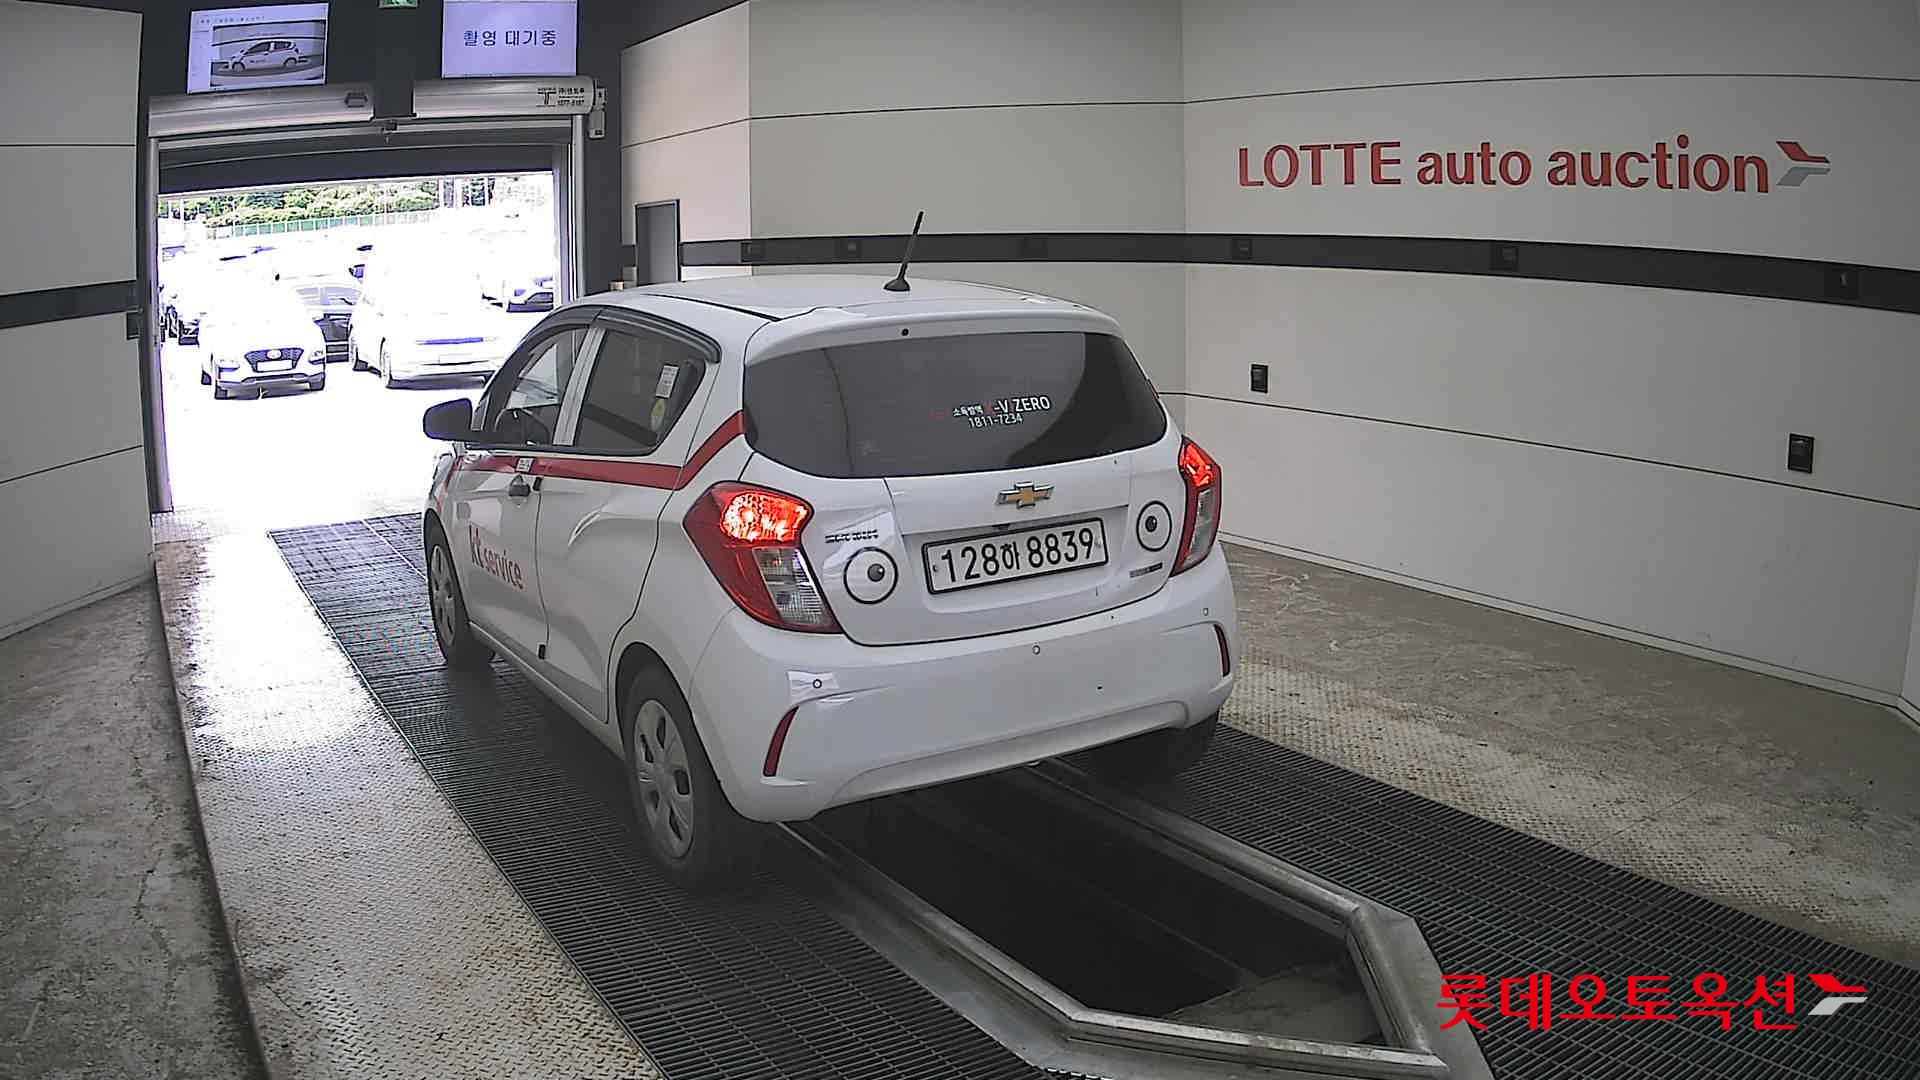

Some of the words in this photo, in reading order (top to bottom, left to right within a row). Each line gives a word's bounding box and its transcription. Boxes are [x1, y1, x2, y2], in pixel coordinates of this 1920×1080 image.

[464, 30, 496, 46] 촬영
[505, 30, 556, 46] 대기중
[1238, 141, 1401, 188] LOTTE
[1416, 142, 1532, 186] auto
[1547, 134, 1769, 193] auction
[1012, 396, 1050, 412] ZERO
[968, 413, 1023, 429] 1811-7234
[484, 547, 524, 590] service
[941, 541, 1020, 582] 128하
[1027, 528, 1095, 568] 8839
